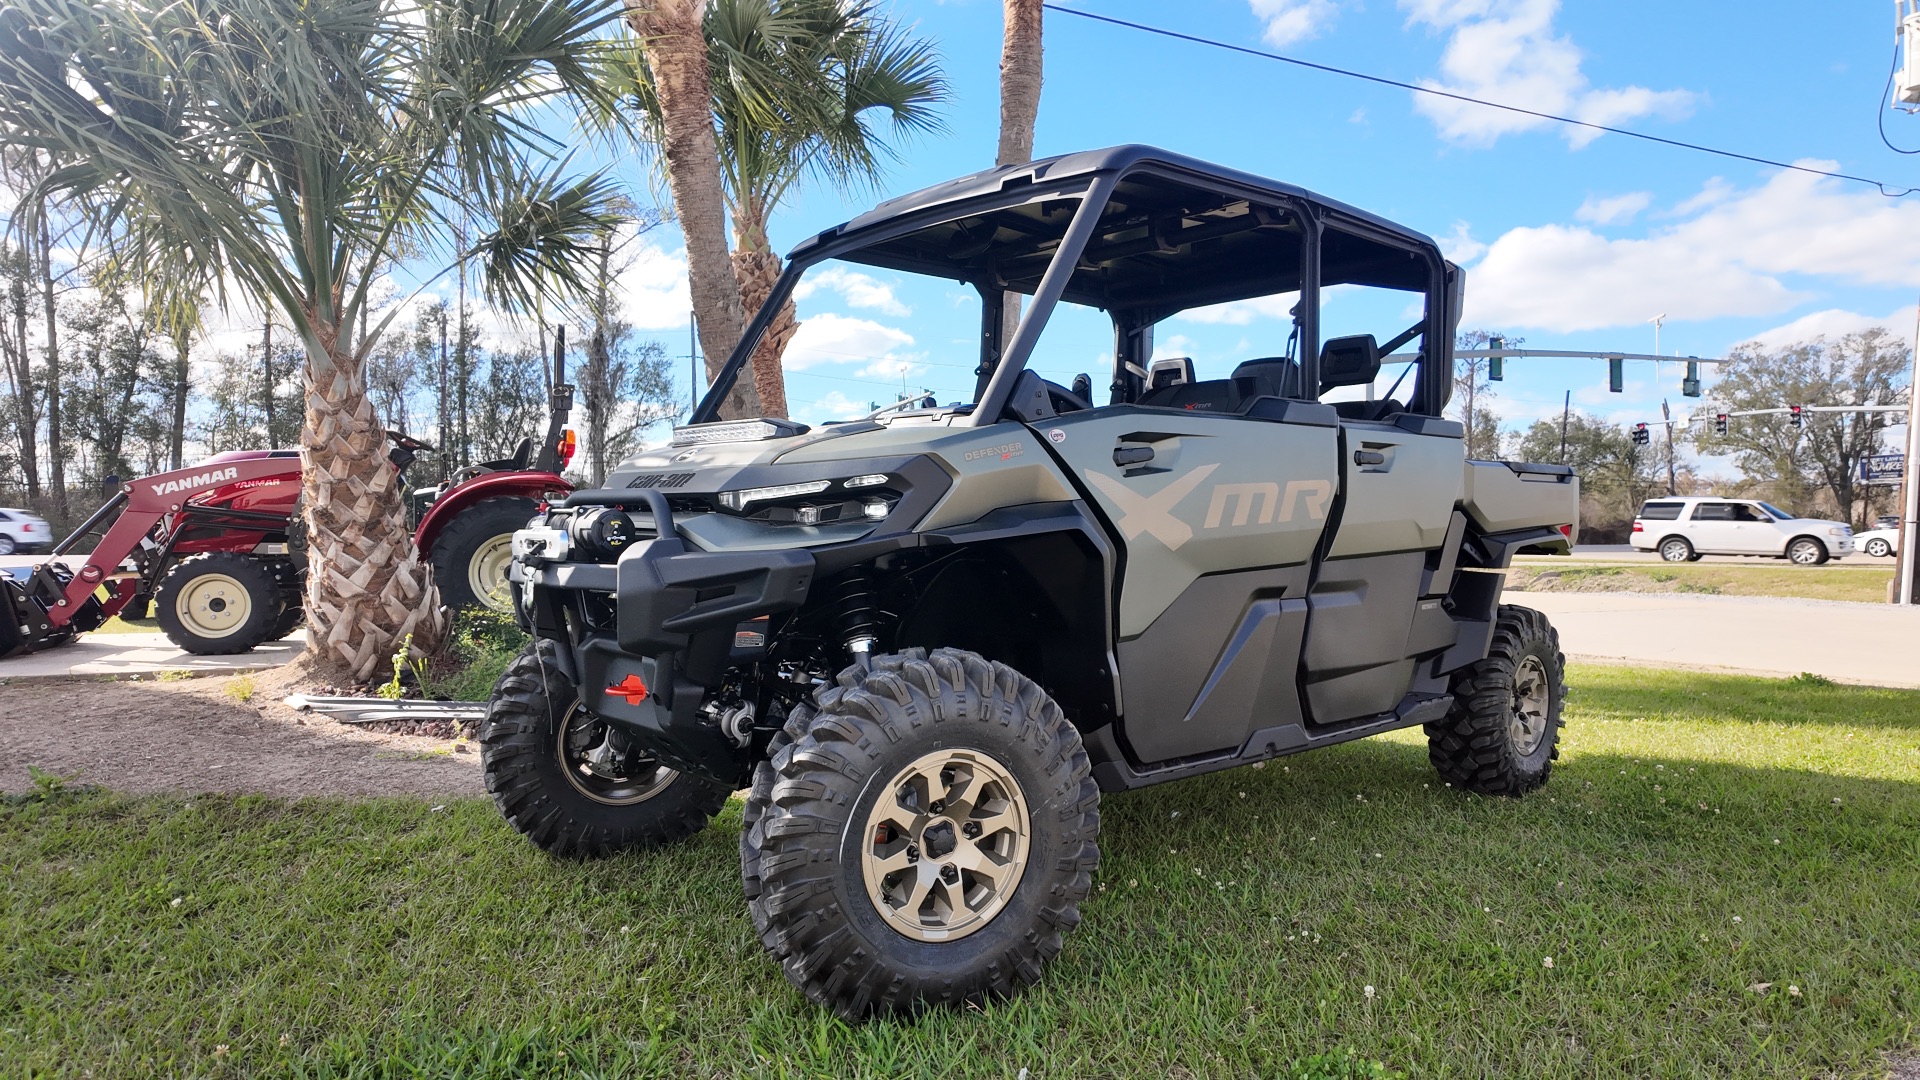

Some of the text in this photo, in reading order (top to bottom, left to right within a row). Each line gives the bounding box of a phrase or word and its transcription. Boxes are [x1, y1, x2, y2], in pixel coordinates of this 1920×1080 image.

[964, 443, 1023, 461] DEFENDER
[151, 467, 238, 496] YANMAR
[234, 479, 280, 488] YANMAR
